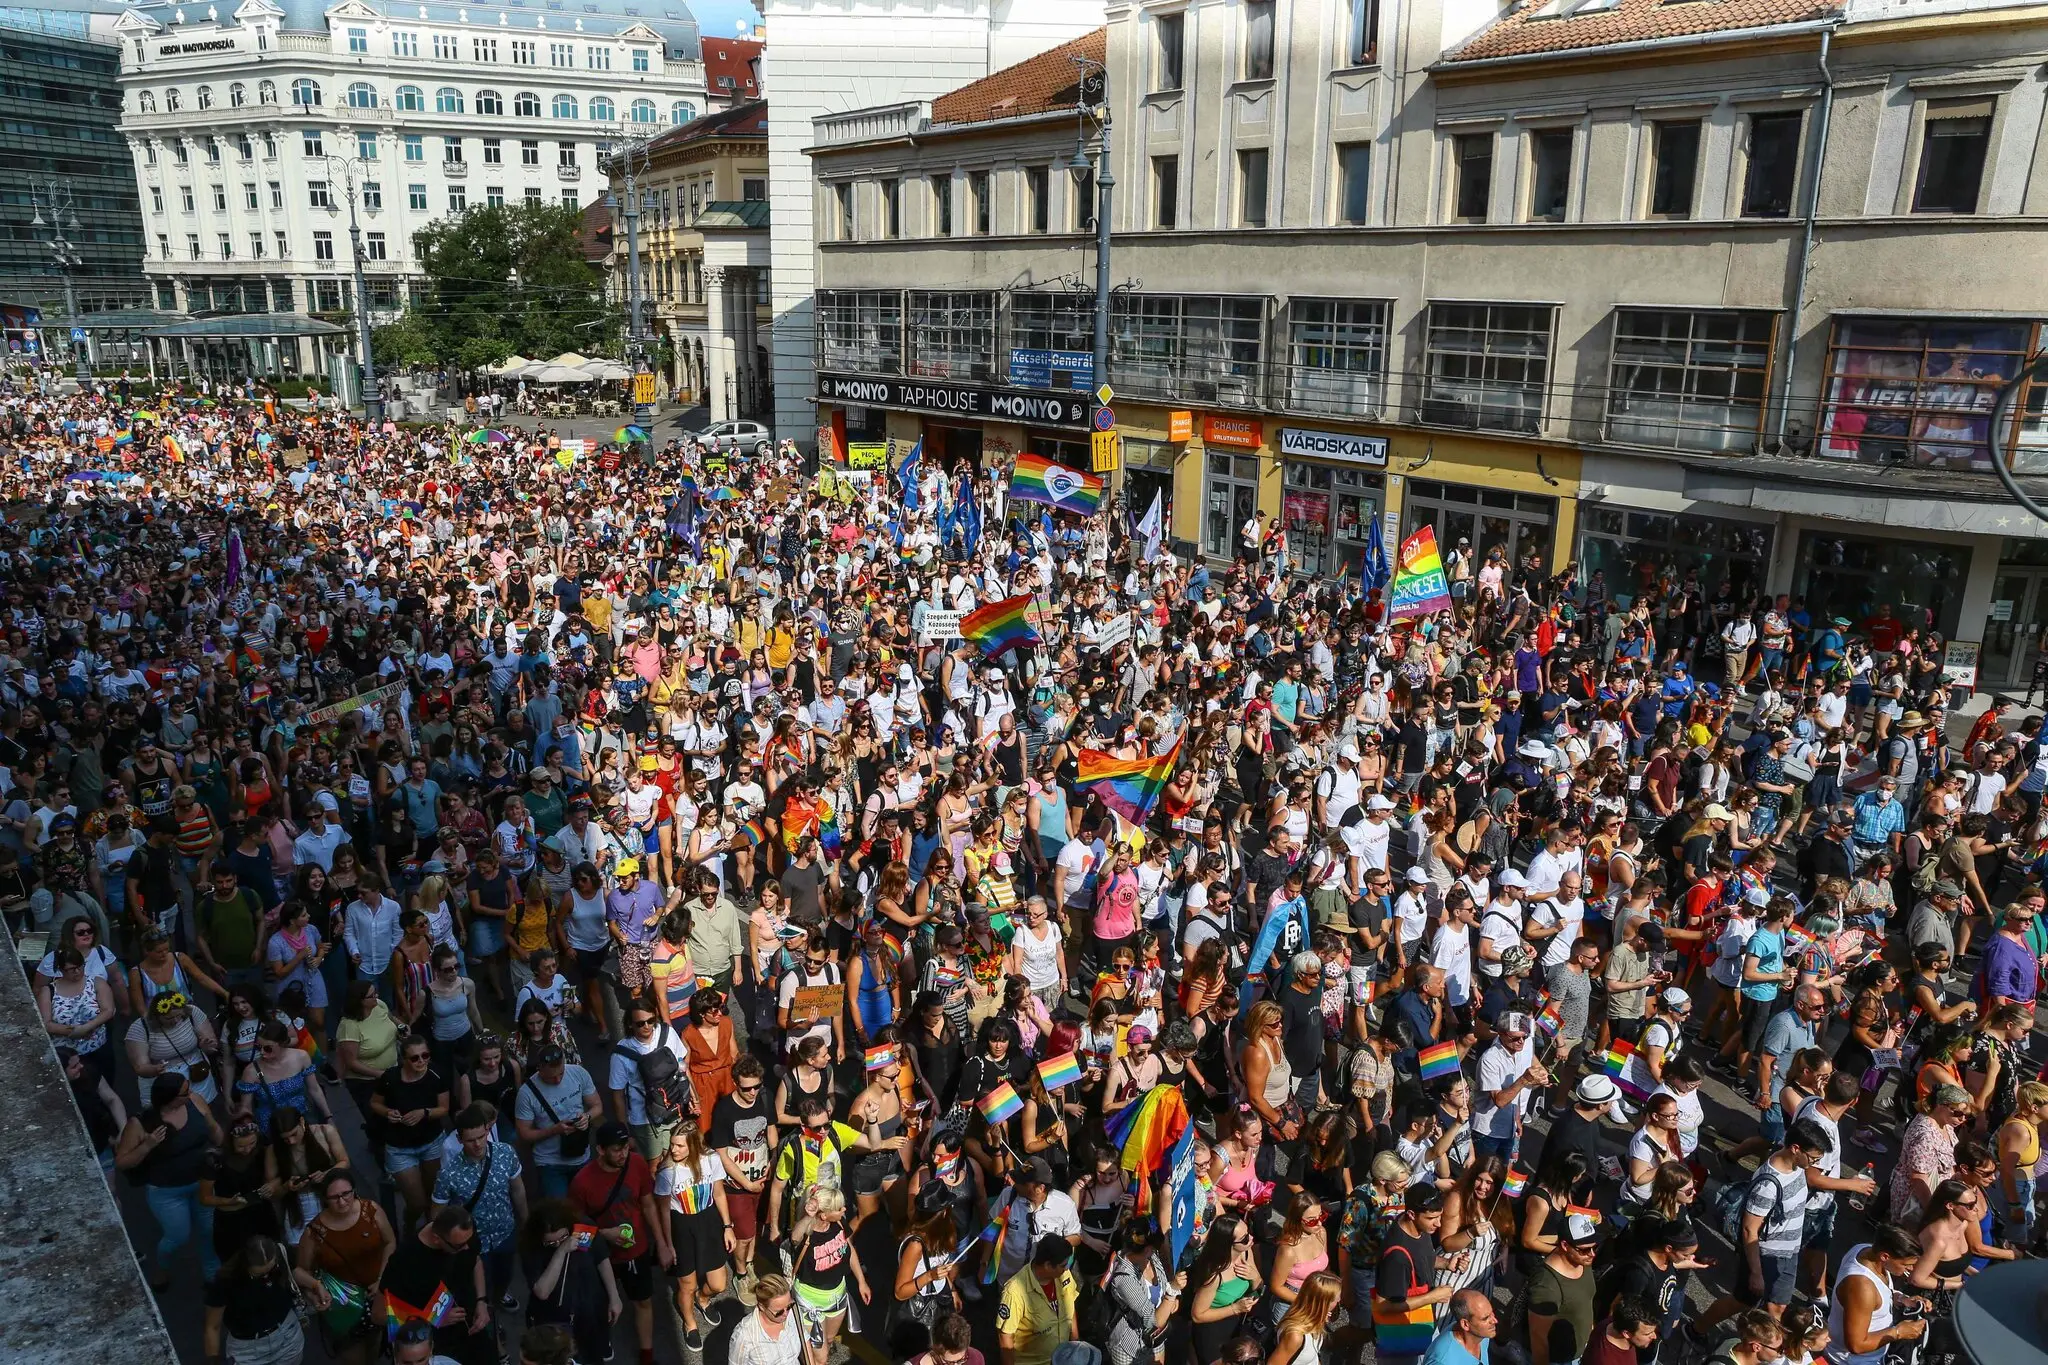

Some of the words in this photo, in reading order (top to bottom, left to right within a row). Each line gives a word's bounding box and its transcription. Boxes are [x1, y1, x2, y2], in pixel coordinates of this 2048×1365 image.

[182, 38, 235, 53] MAGYARORSZÁG
[1012, 350, 1093, 368] Kecseti-Generál
[835, 380, 888, 401] MONYO
[991, 396, 1062, 420] MONYO
[1853, 385, 1995, 412] LIFESTYLE
[1172, 418, 1191, 426] CHANGE
[1214, 421, 1250, 432] CHANGE
[1284, 430, 1385, 459] VÁROSKAPU
[927, 613, 948, 621] Szegedi
[1123, 892, 1132, 900] 18
[873, 1050, 889, 1064] 25
[815, 1251, 842, 1271] HILLS
[432, 1291, 449, 1316] 25
